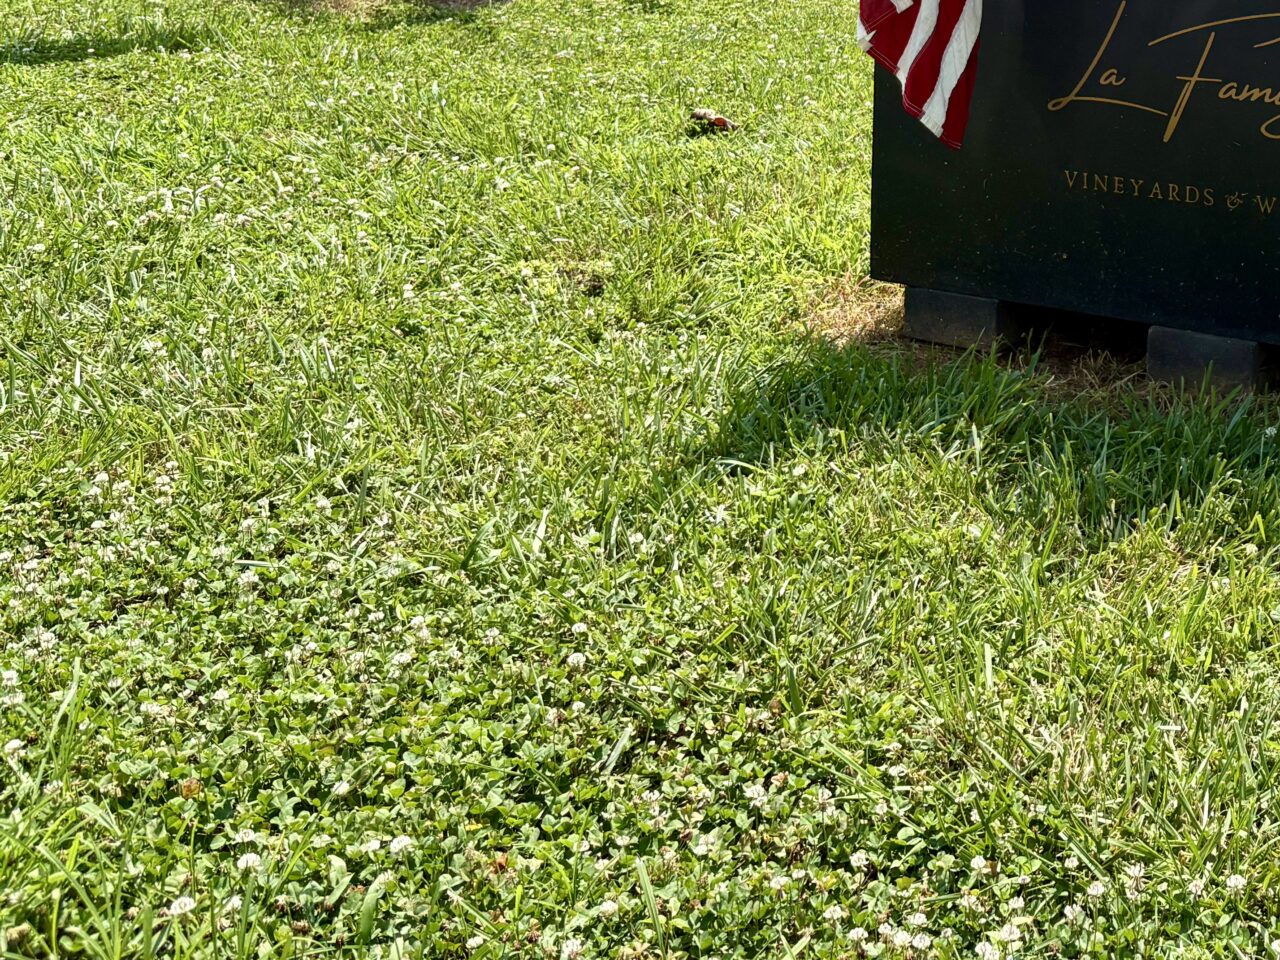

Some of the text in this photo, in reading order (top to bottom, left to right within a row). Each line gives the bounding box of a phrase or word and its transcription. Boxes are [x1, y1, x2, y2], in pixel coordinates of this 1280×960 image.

[1047, 0, 1168, 116] La
[1064, 170, 1215, 207] VINEYARDS
[1224, 191, 1248, 209] &
